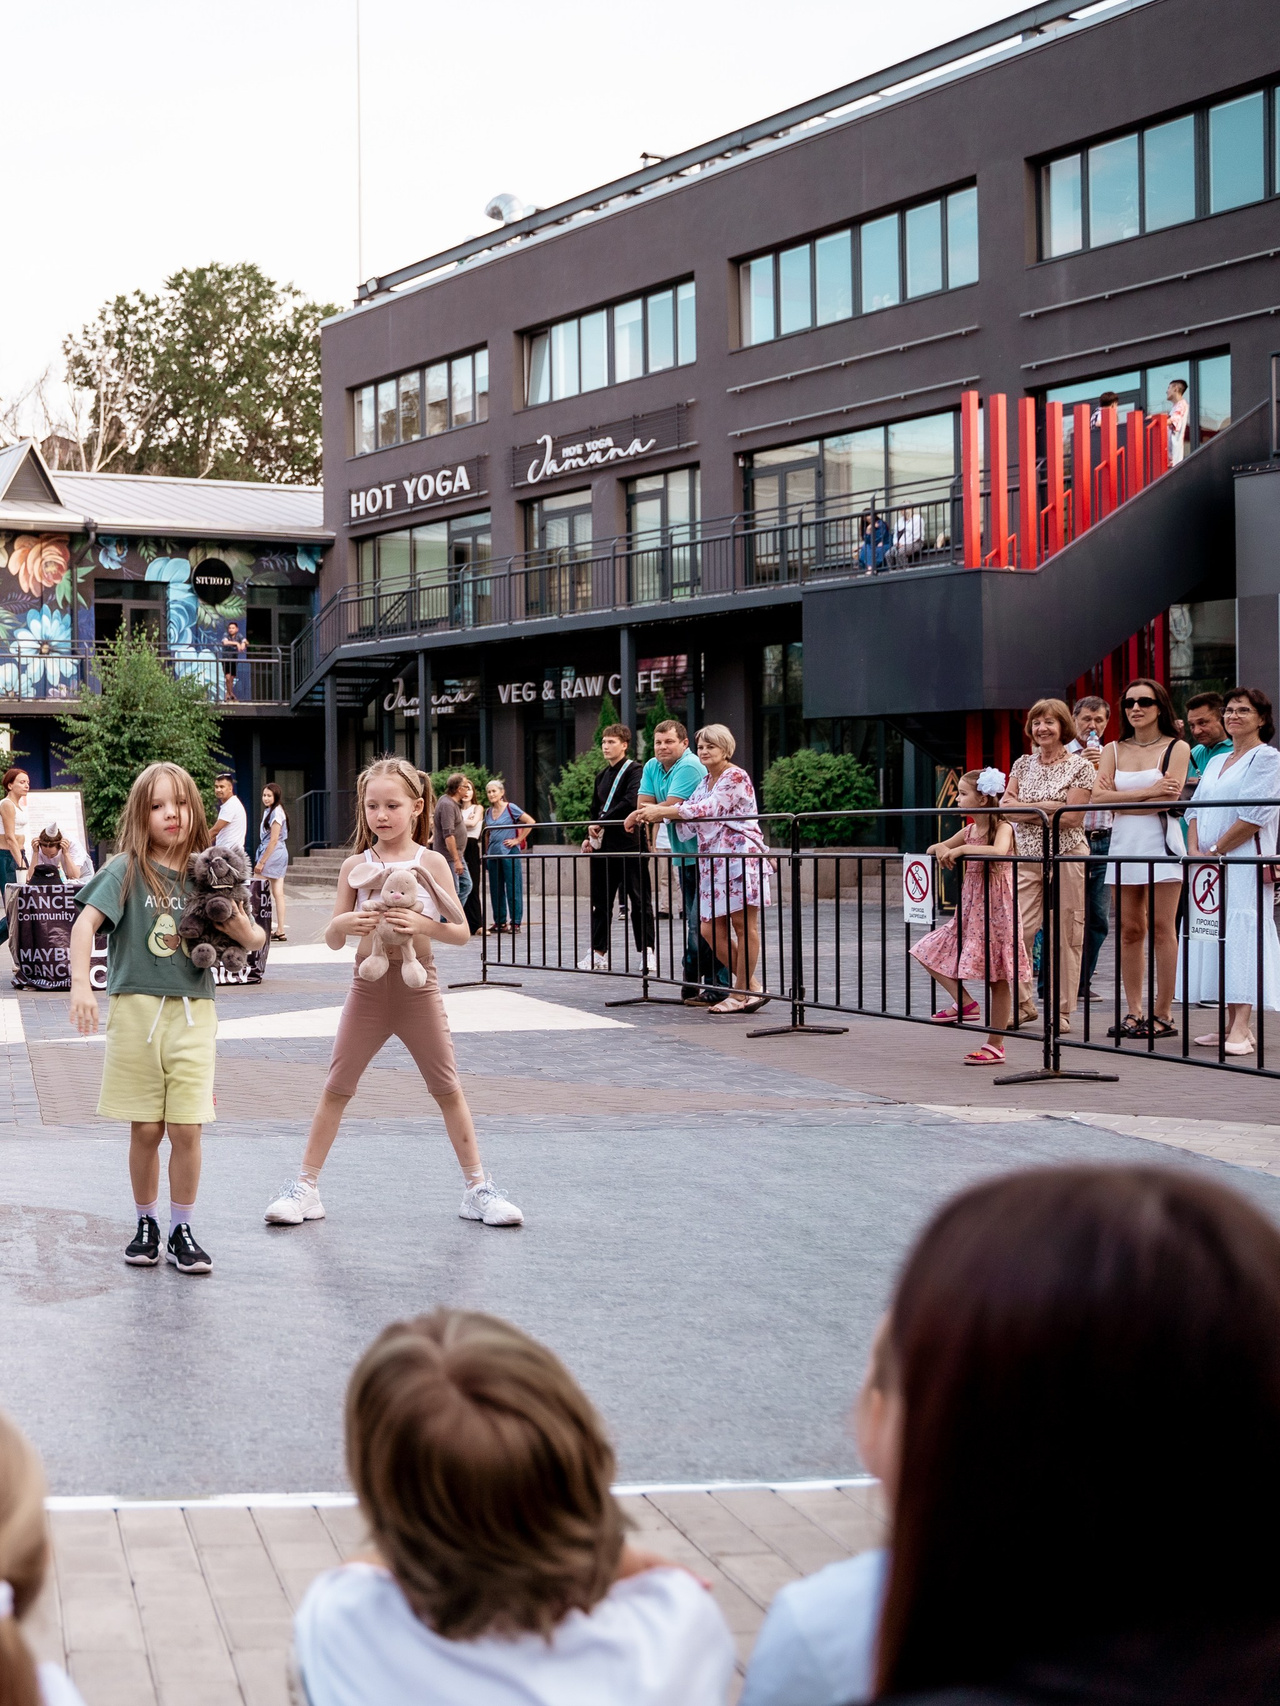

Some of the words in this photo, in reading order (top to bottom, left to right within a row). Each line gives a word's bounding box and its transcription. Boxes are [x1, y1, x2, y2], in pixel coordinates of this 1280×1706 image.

[562, 444, 584, 458] HOT
[585, 437, 614, 452] YOGA
[527, 434, 656, 484] Jamuna
[350, 484, 396, 518] HOT
[402, 466, 471, 504] YOGA
[498, 682, 536, 703] VEG
[542, 680, 555, 700] &
[561, 675, 604, 699] RAW
[608, 670, 663, 695] CFE
[17, 895, 75, 910] DANCE
[17, 911, 75, 922] Community
[1195, 918, 1218, 928] ПРОХОД
[1191, 927, 1220, 936] ЗАПРЕЩЕ
[20, 947, 72, 962] MAYB
[22, 963, 72, 977] DANC
